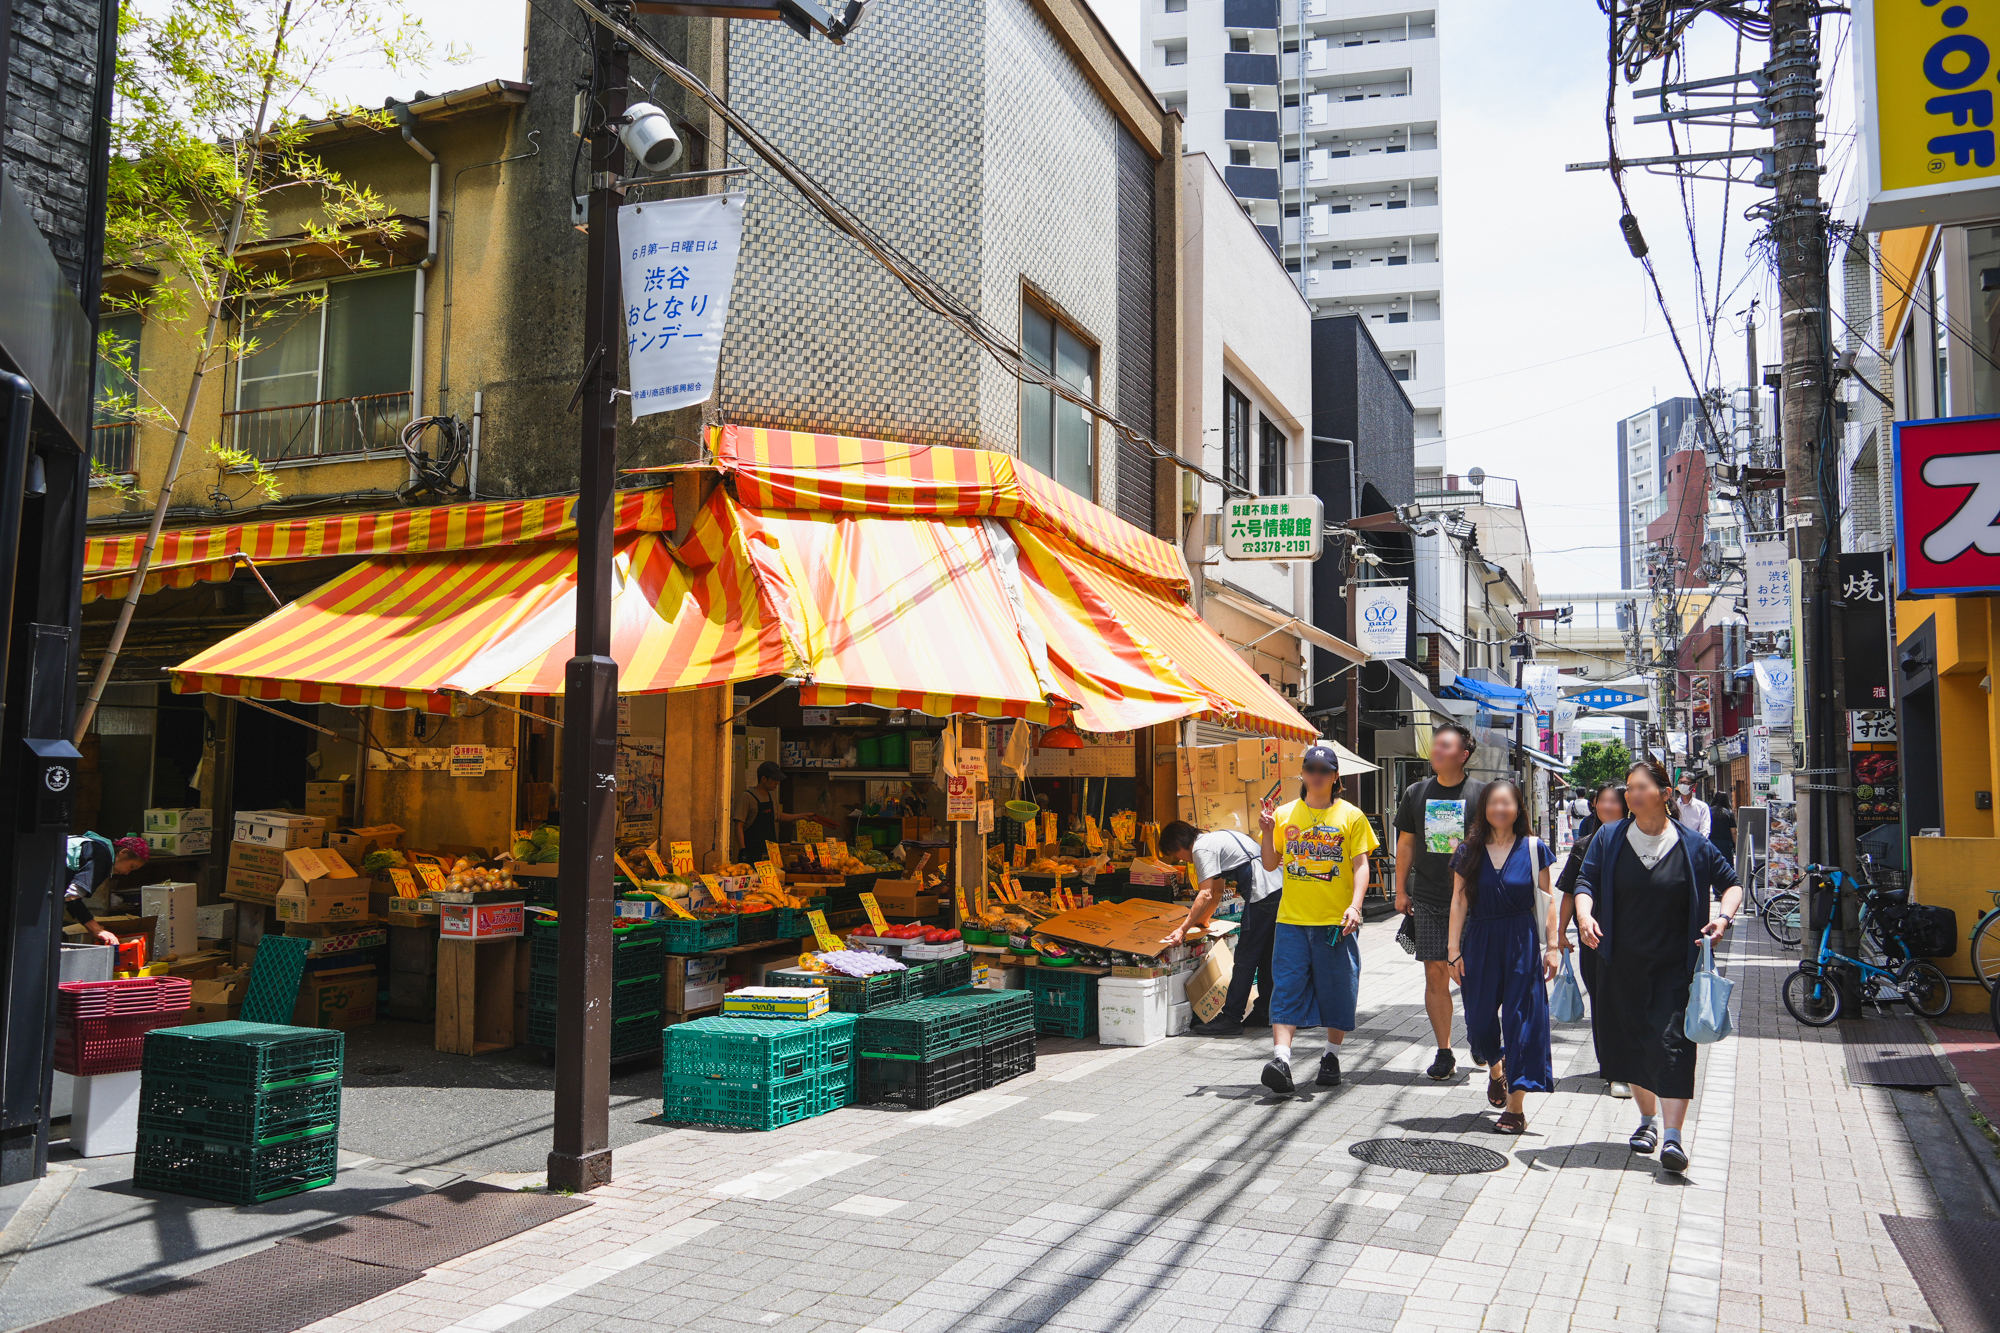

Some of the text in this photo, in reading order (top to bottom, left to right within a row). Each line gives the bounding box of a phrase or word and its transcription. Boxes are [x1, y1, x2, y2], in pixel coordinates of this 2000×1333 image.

[632, 240, 718, 260] 6月第一日曜日は
[644, 266, 690, 292] 渋谷
[628, 294, 708, 327] おとなり
[628, 324, 703, 358] サンデー
[1230, 517, 1312, 538] 六号情報館
[1254, 540, 1310, 553] 3378-2191
[1843, 570, 1884, 602] 焼
[1572, 694, 1634, 702] 六号通商店街
[1286, 840, 1343, 857] fifties
[424, 873, 447, 891] 180
[751, 1003, 775, 1011] RIVAS
